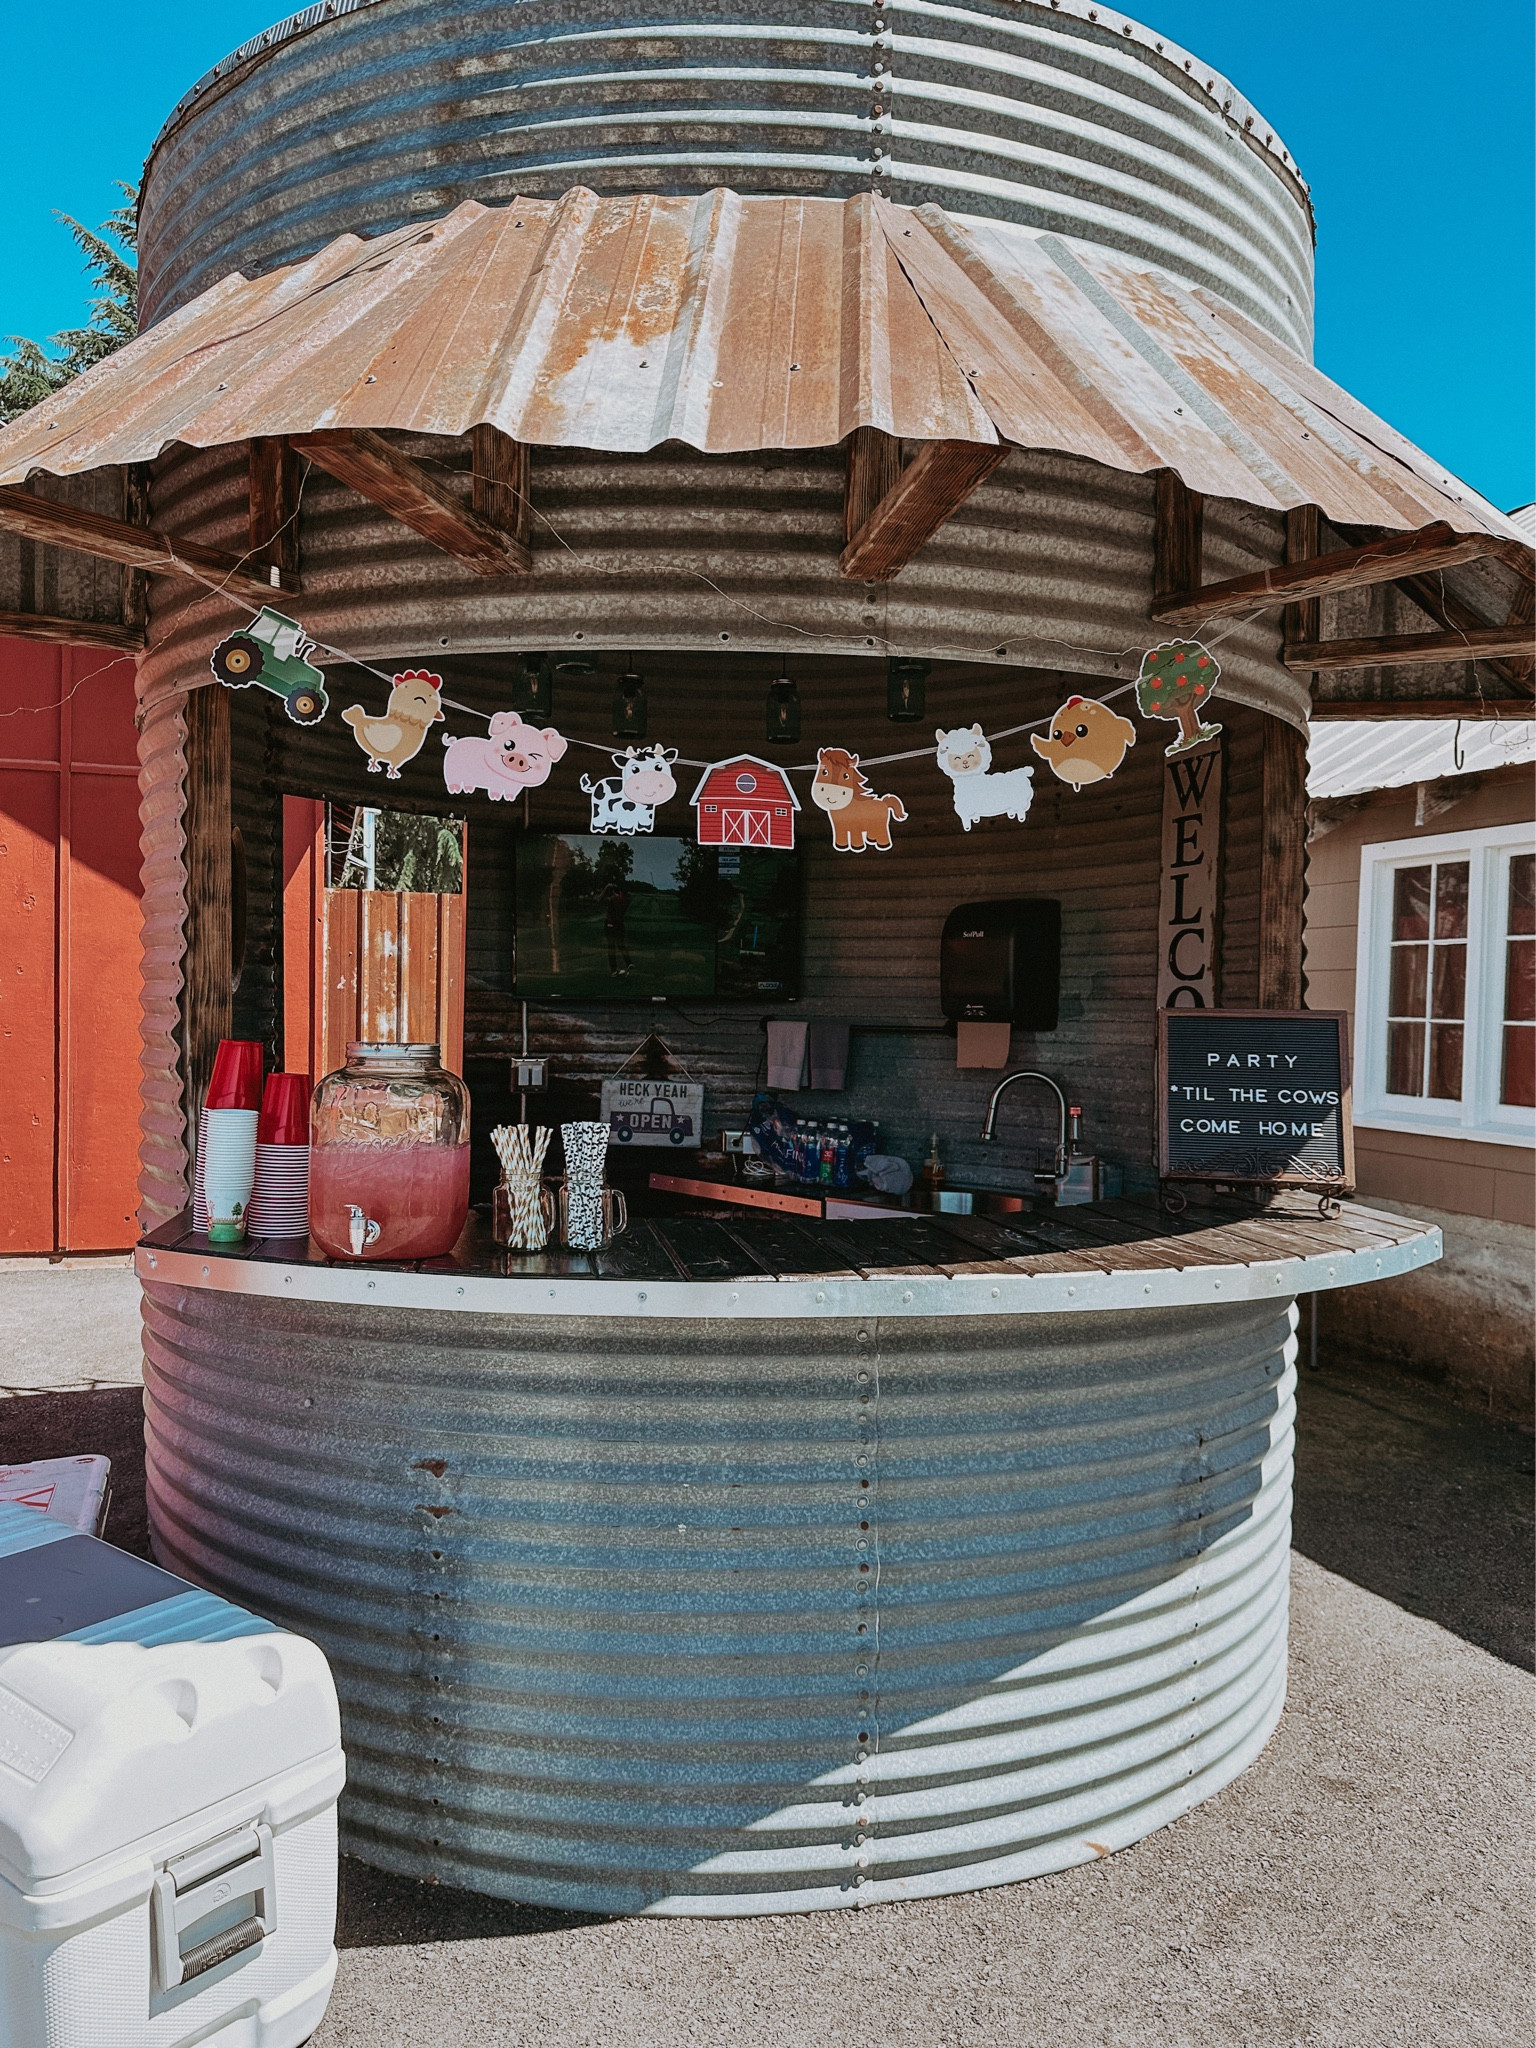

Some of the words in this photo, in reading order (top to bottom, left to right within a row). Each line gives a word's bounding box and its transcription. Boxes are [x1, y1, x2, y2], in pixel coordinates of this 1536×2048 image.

[1207, 1053, 1298, 1069] PARTY
[619, 1082, 650, 1097] HECK
[655, 1084, 688, 1098] YEAH
[1229, 1088, 1268, 1102] THE
[1277, 1090, 1339, 1105] COWS
[629, 1113, 672, 1129] OPEN
[1180, 1118, 1241, 1134] COME
[1259, 1121, 1324, 1137] HOME
